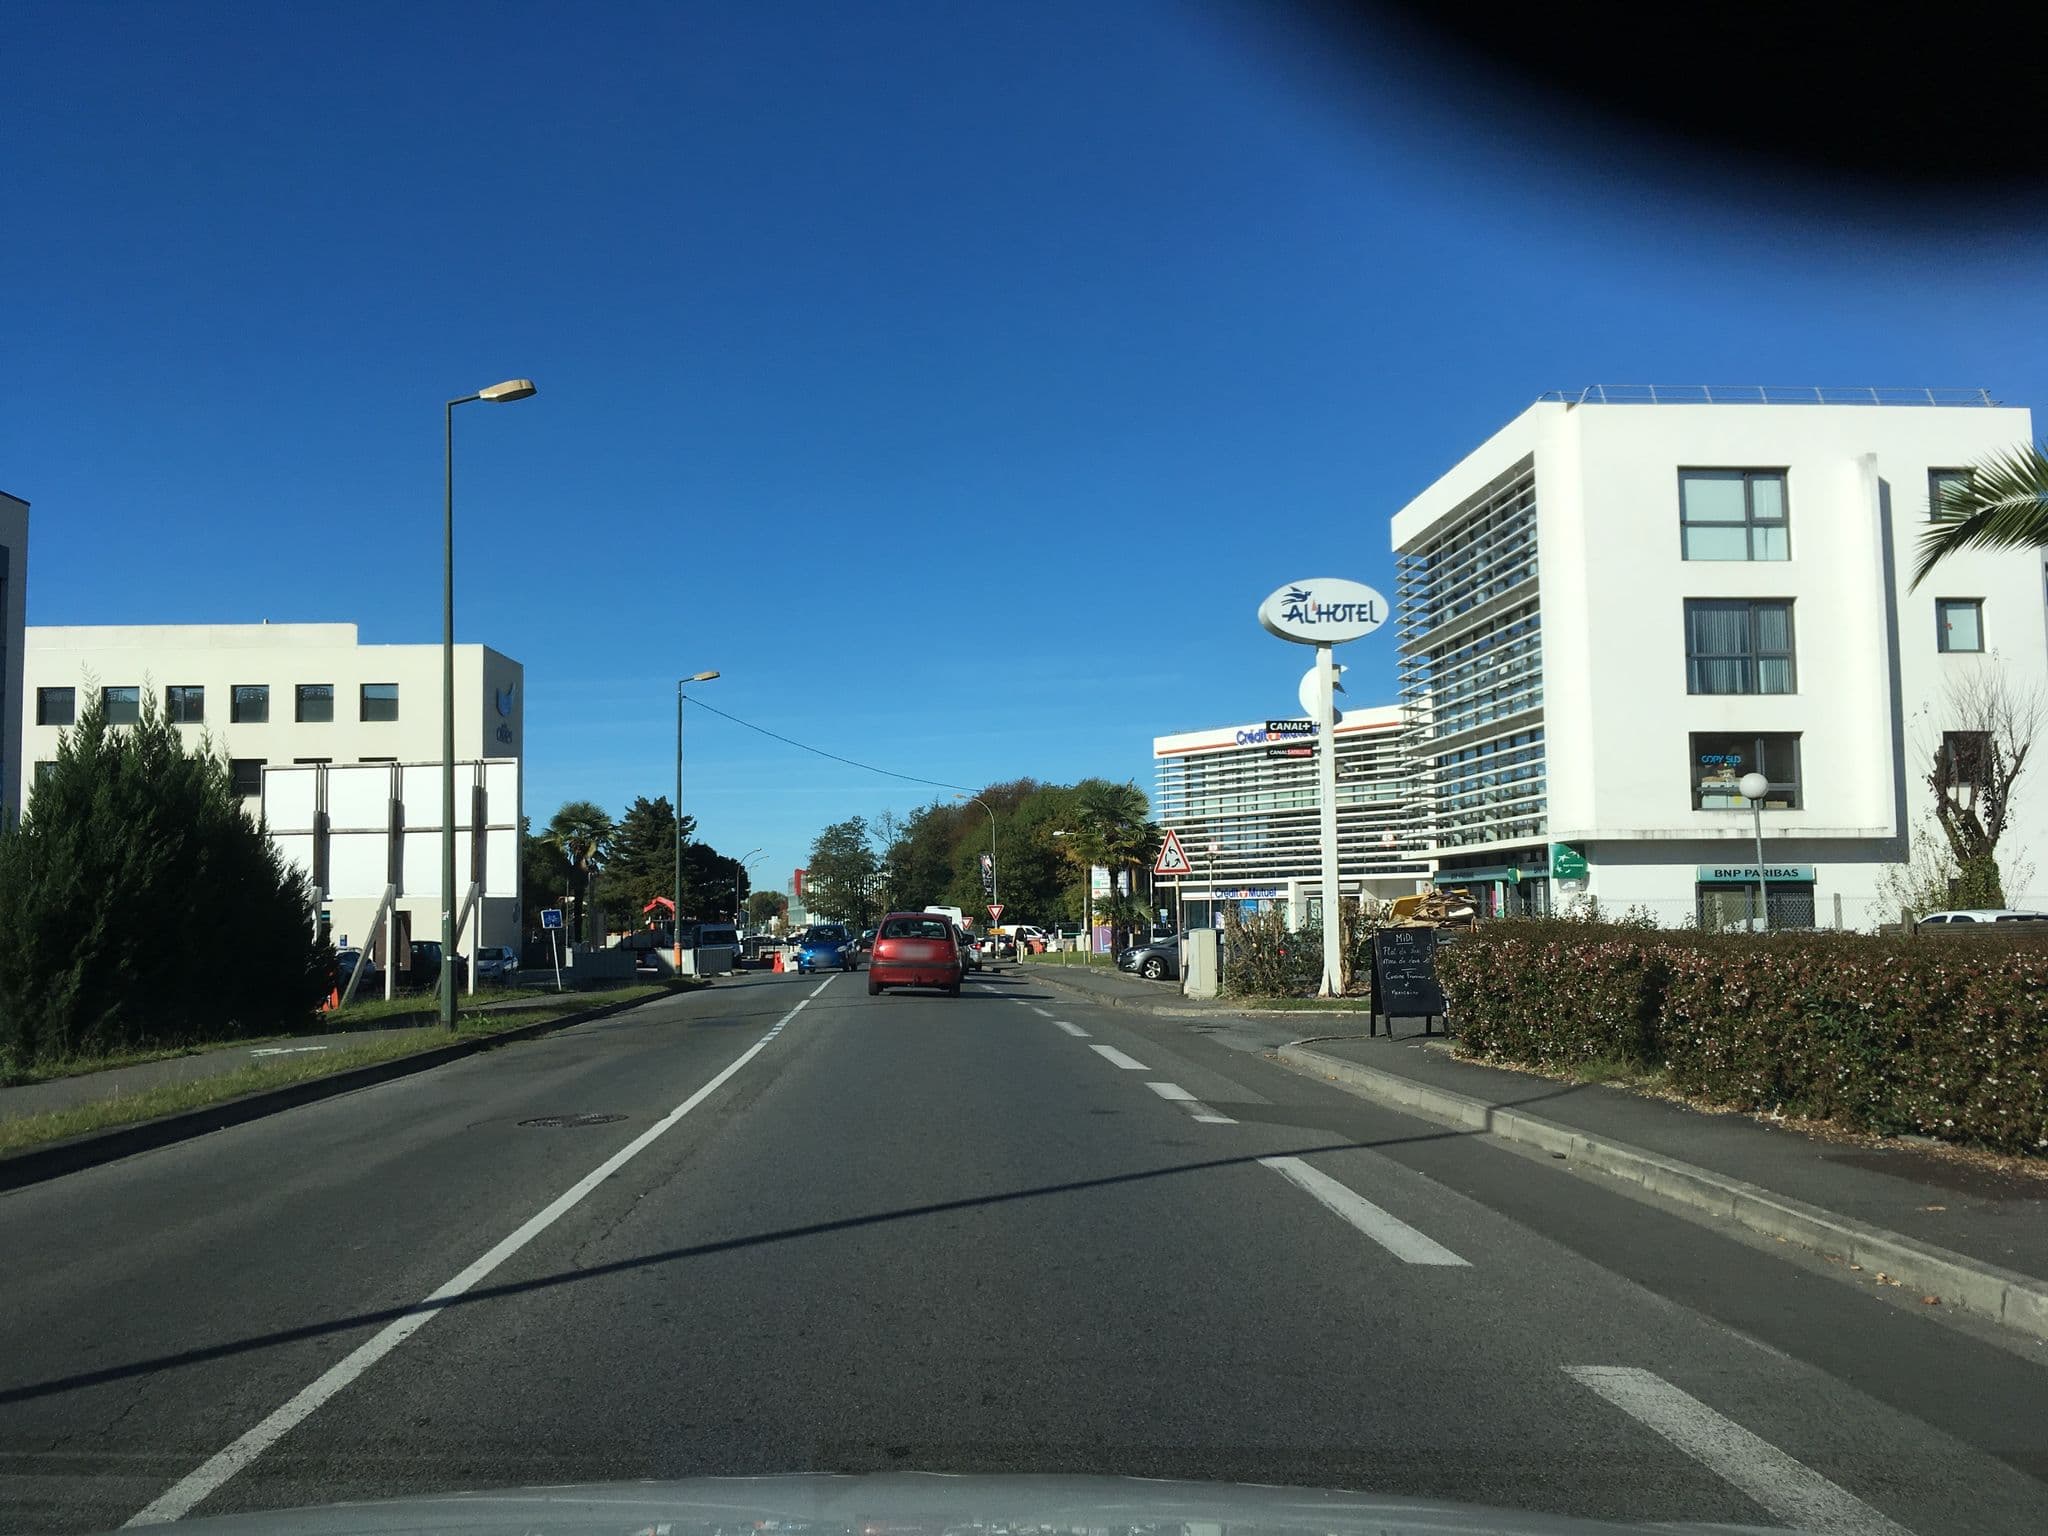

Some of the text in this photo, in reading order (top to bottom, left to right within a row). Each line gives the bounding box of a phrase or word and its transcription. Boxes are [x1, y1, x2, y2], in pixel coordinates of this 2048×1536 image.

[1270, 722, 1311, 731] CANAL+
[1701, 755, 1724, 763] COPY
[1714, 868, 1799, 878] BNP PARIBAS
[1248, 886, 1277, 898] Mutuel
